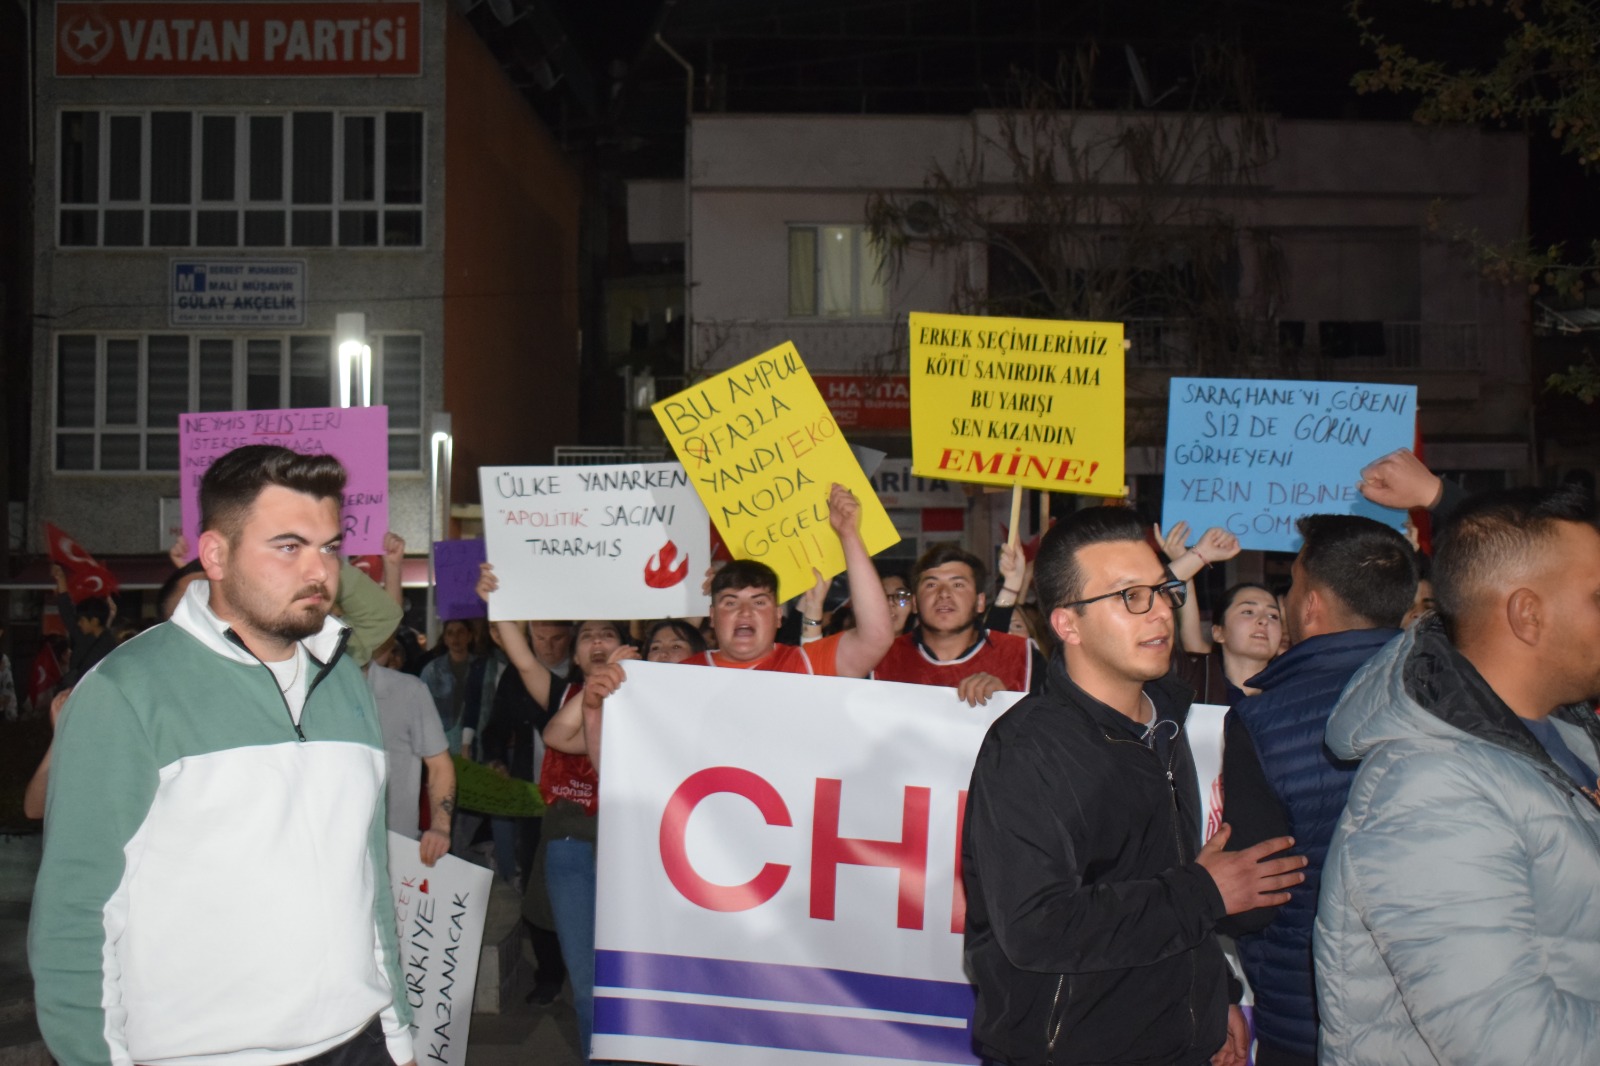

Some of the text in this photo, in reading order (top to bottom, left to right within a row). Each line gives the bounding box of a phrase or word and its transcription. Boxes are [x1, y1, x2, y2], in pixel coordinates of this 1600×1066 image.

[119, 16, 407, 62] VATAN PARTİSİ
[178, 294, 296, 311] GÜLAY AKÇELİK
[209, 279, 238, 291] MALİ
[919, 326, 1108, 356] ERKEK SEÇİMLERİMİZ
[925, 352, 1101, 386] KÖTÜ SANIRDIK AMA
[663, 352, 804, 436] BU AMPUL
[970, 390, 1054, 418] BU YARIŞI
[951, 417, 1077, 446] SEN KAZANDIN
[1249, 415, 1279, 438] DE
[1294, 407, 1372, 447] GÖRÜN
[700, 442, 785, 494] YANDI
[869, 467, 949, 492] ARİTA
[937, 447, 1100, 485] EMİNE!
[496, 470, 688, 499] ÜLKE YANARKEN
[721, 467, 815, 528] MODA
[404, 898, 436, 1028] ÜRKİYE
[427, 892, 471, 1065] KAZANACAK
